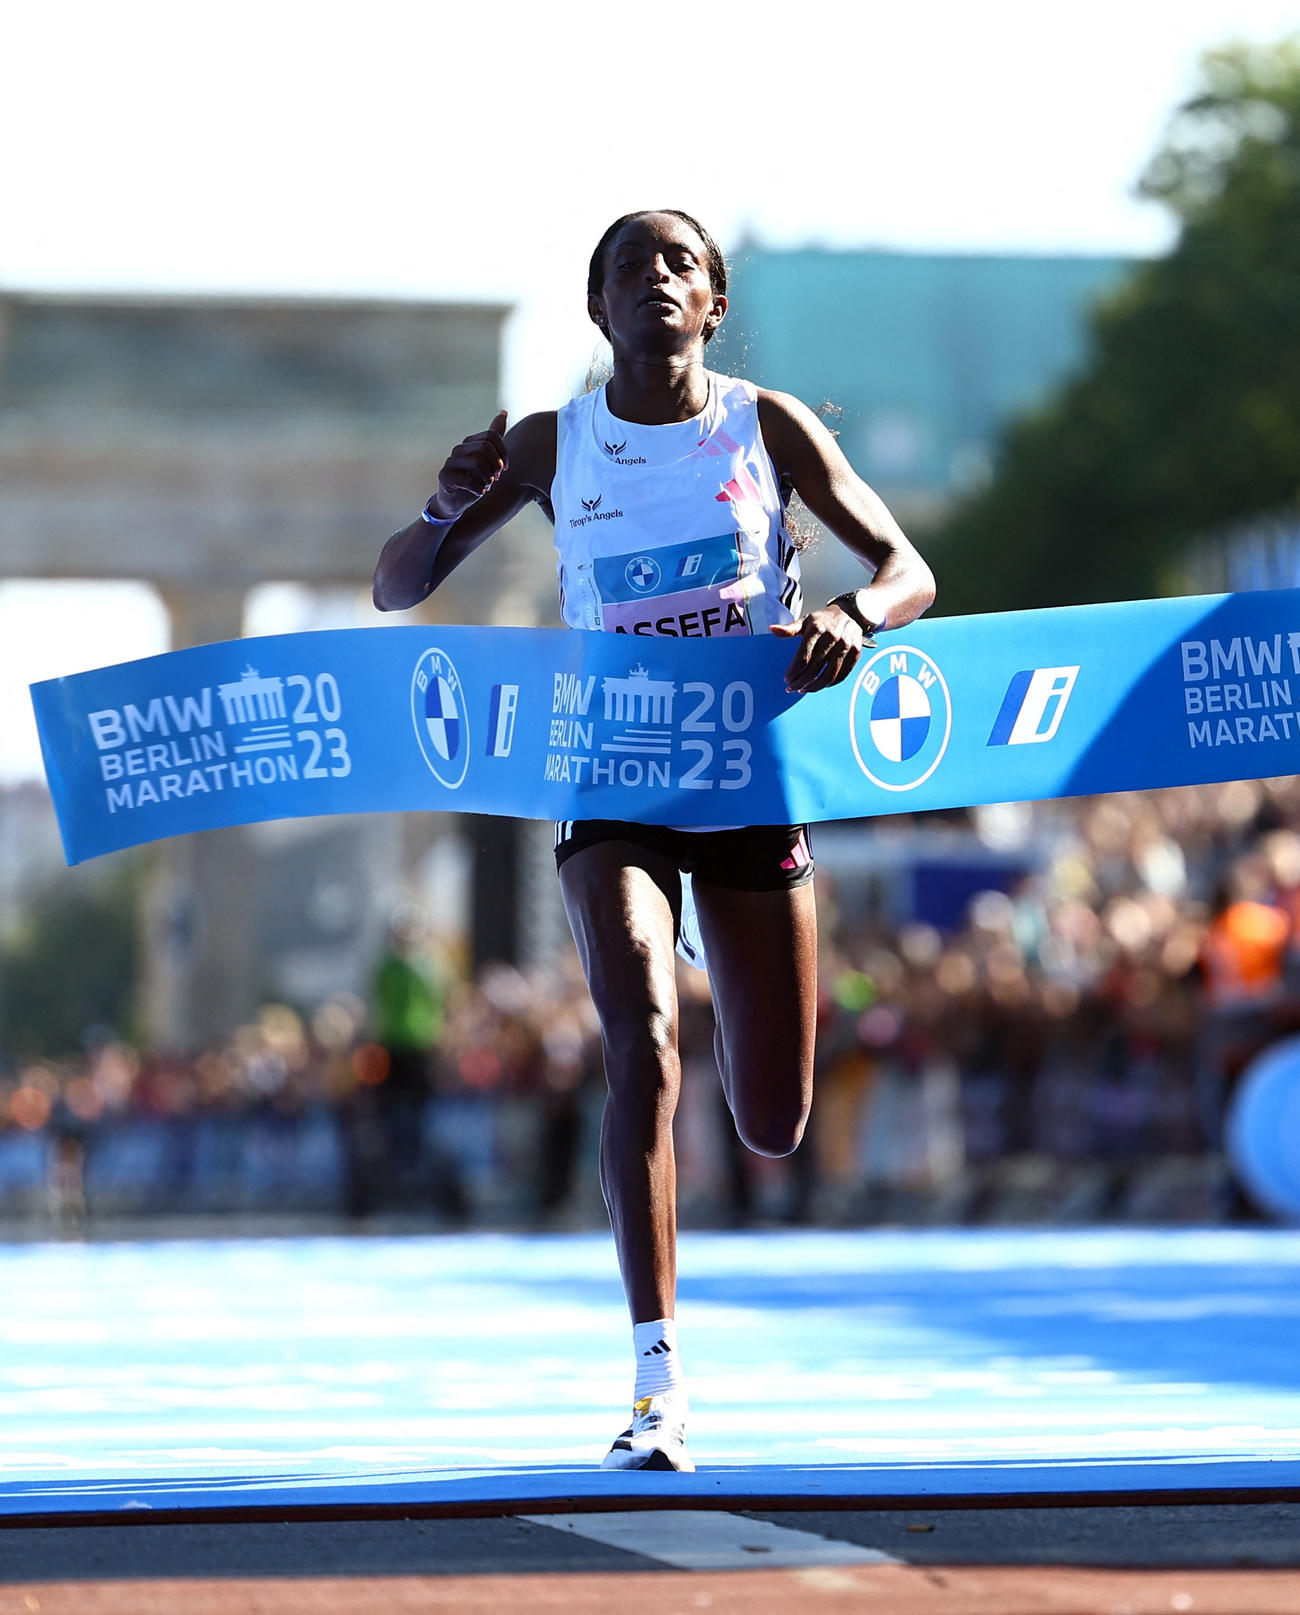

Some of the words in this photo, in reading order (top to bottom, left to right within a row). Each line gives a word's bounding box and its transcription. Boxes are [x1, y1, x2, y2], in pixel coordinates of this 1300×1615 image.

[615, 457, 647, 466] Angels
[569, 514, 592, 528] Tirop's
[593, 509, 624, 521] Angels
[417, 655, 457, 693] BMW
[862, 653, 937, 696] BMW
[1181, 633, 1282, 682] BMW
[87, 687, 212, 750] BMW
[286, 672, 342, 724] 20
[552, 672, 597, 716] BMW
[680, 680, 754, 733] 20
[1184, 679, 1292, 714] BERLIN
[297, 728, 352, 779] 23
[1187, 712, 1300, 748] MARAT
[100, 731, 227, 781] BERLIN
[678, 738, 753, 790] 23
[105, 755, 299, 814] MARATHON
